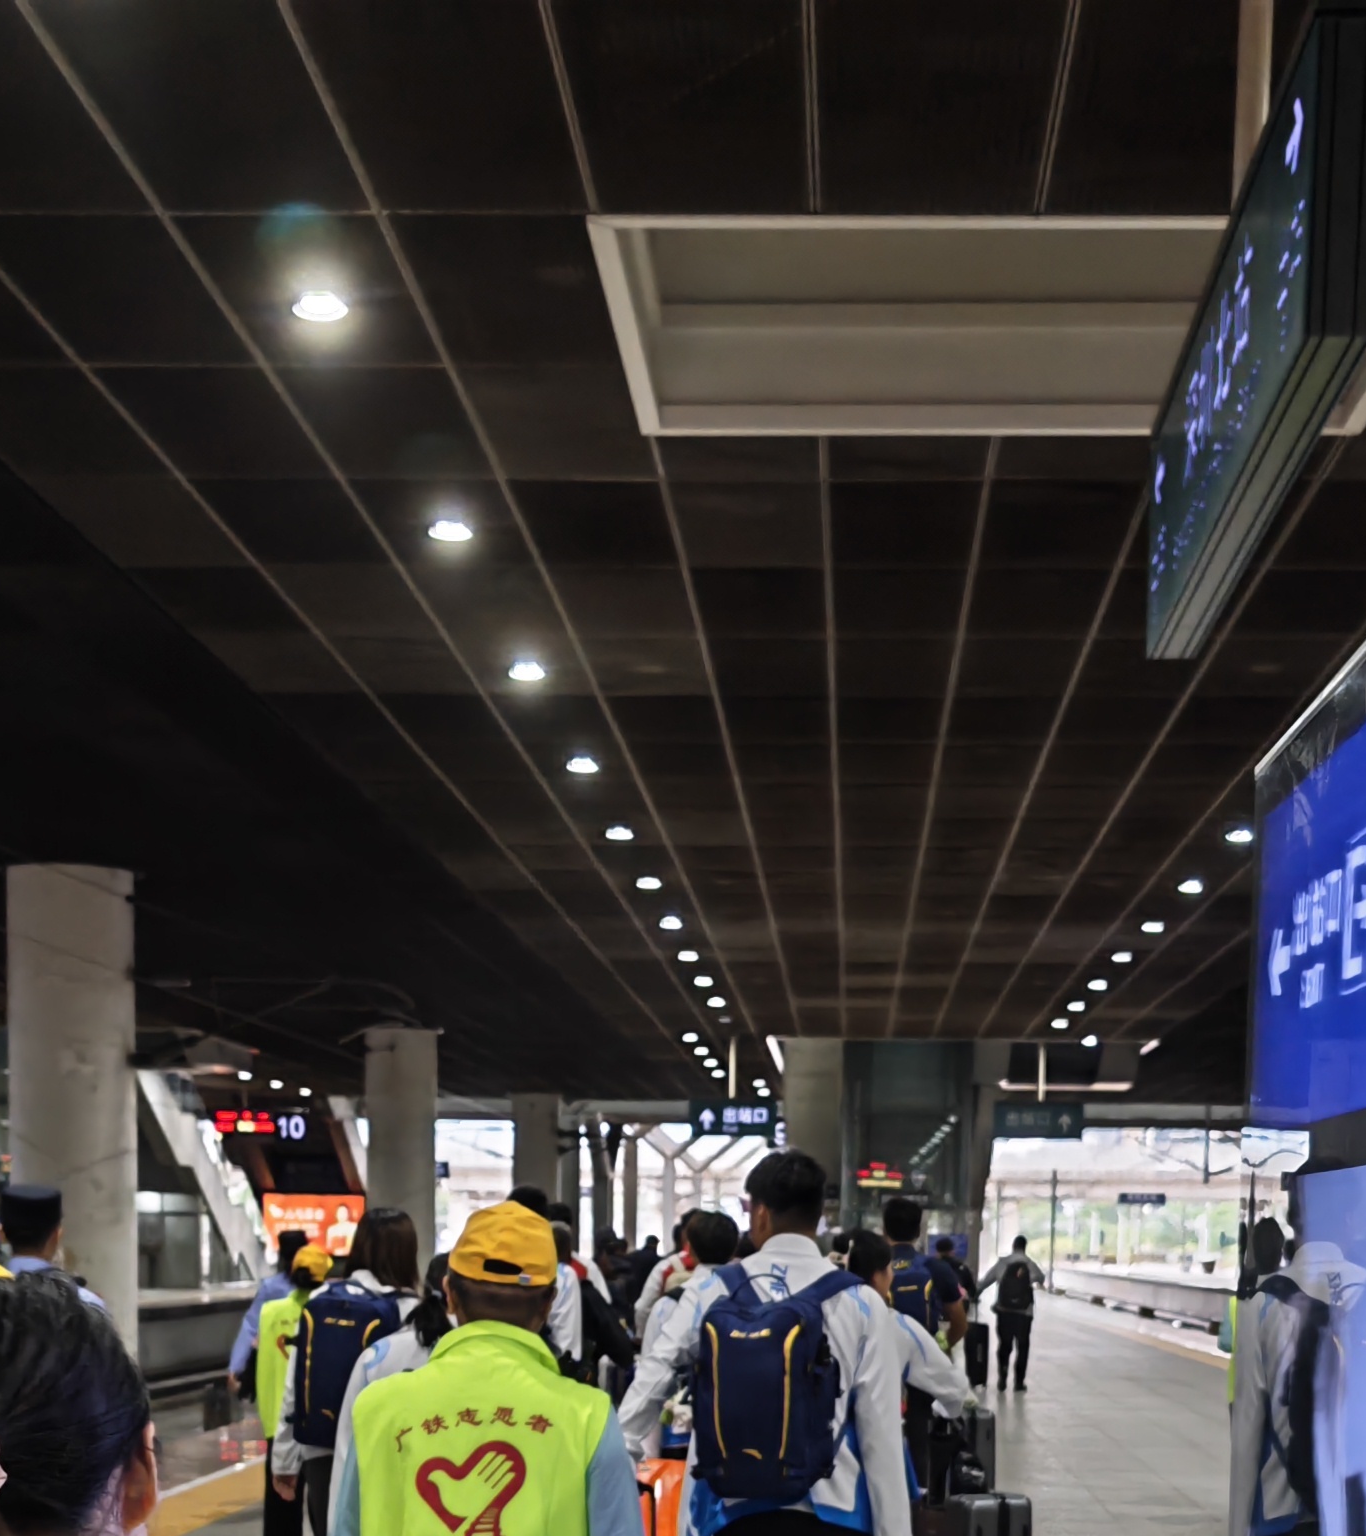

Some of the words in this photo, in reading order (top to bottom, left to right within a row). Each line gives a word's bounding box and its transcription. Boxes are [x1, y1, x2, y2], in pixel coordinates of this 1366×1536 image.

[277, 1115, 306, 1139] 10
[394, 1405, 554, 1453] 广铁志愿者
